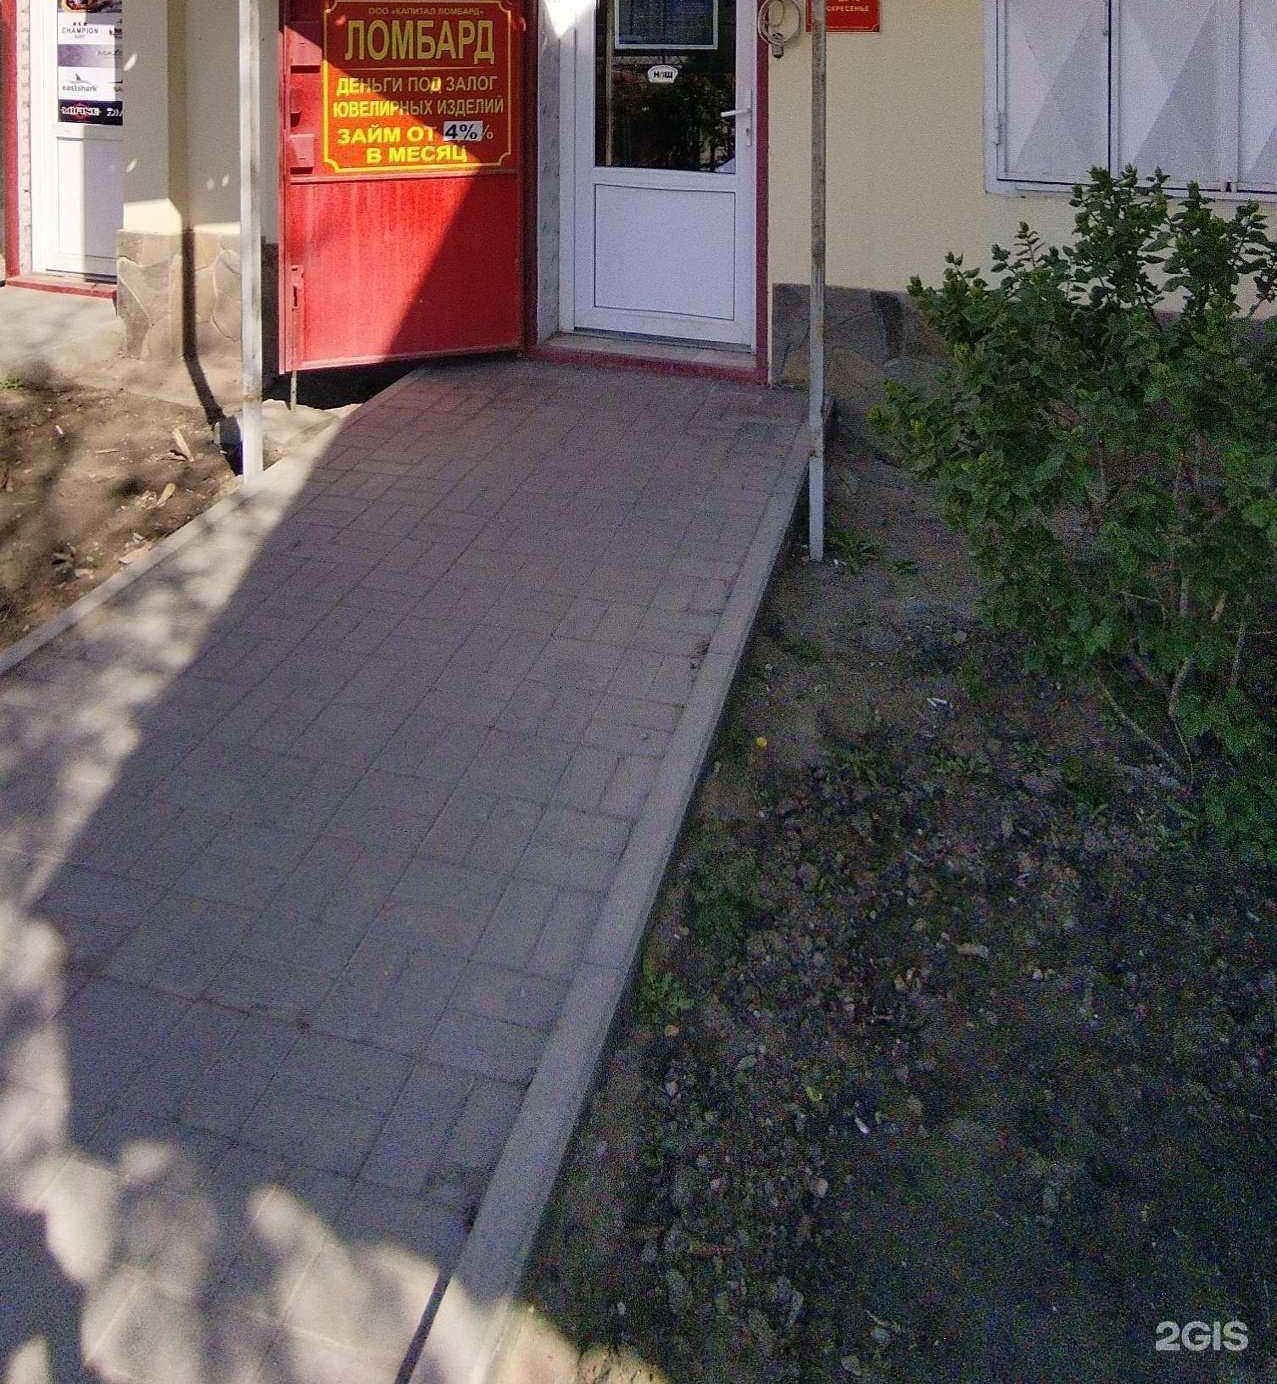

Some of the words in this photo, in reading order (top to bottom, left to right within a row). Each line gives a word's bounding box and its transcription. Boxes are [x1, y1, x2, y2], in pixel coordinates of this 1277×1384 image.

[62, 27, 98, 35] CHAMPION
[345, 19, 495, 65] ЛОМБАРД
[336, 77, 402, 97] ДЕНЬГИ
[408, 76, 442, 94] ПОД
[446, 75, 498, 93] ЗАЛОГ
[333, 100, 433, 118] ЮВЕЛИРНЫХ
[437, 96, 504, 116] ИЗДЕЛИЙ
[336, 124, 401, 144] ЗАЙМ
[406, 125, 438, 142] ОТ
[366, 147, 382, 163] В
[389, 145, 468, 163] МЕСЯЦ
